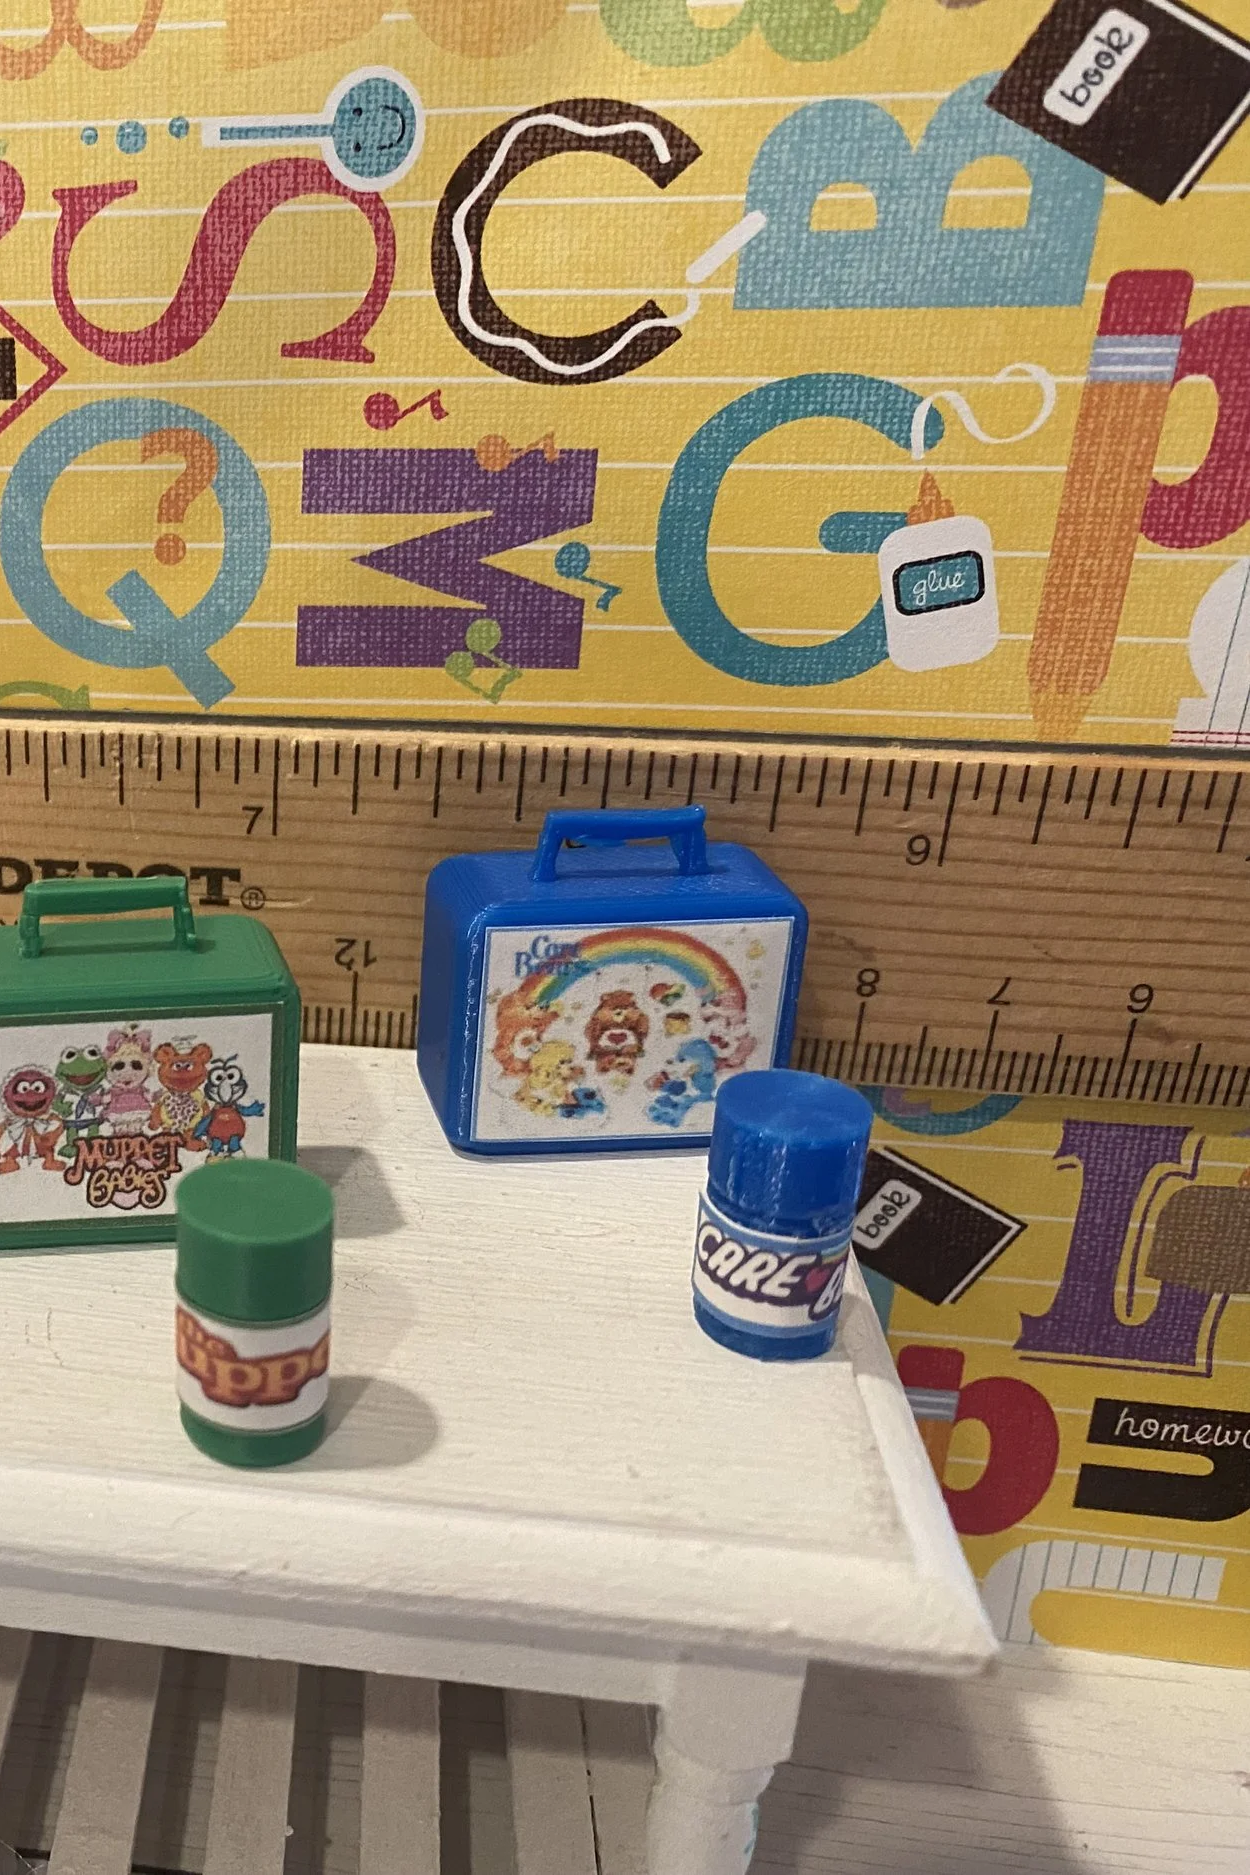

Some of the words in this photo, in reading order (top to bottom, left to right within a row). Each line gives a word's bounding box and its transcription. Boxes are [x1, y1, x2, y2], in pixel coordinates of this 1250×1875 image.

[1060, 26, 1134, 108] book
[431, 98, 704, 386] C
[912, 566, 968, 603] glue
[242, 806, 264, 834] 7
[905, 834, 931, 866] 9
[334, 937, 378, 970] 12
[856, 968, 880, 997] 8
[986, 976, 1012, 1007] 7
[63, 1132, 184, 1185] MUPPET
[856, 1190, 911, 1239] book
[698, 1223, 818, 1299] CARE
